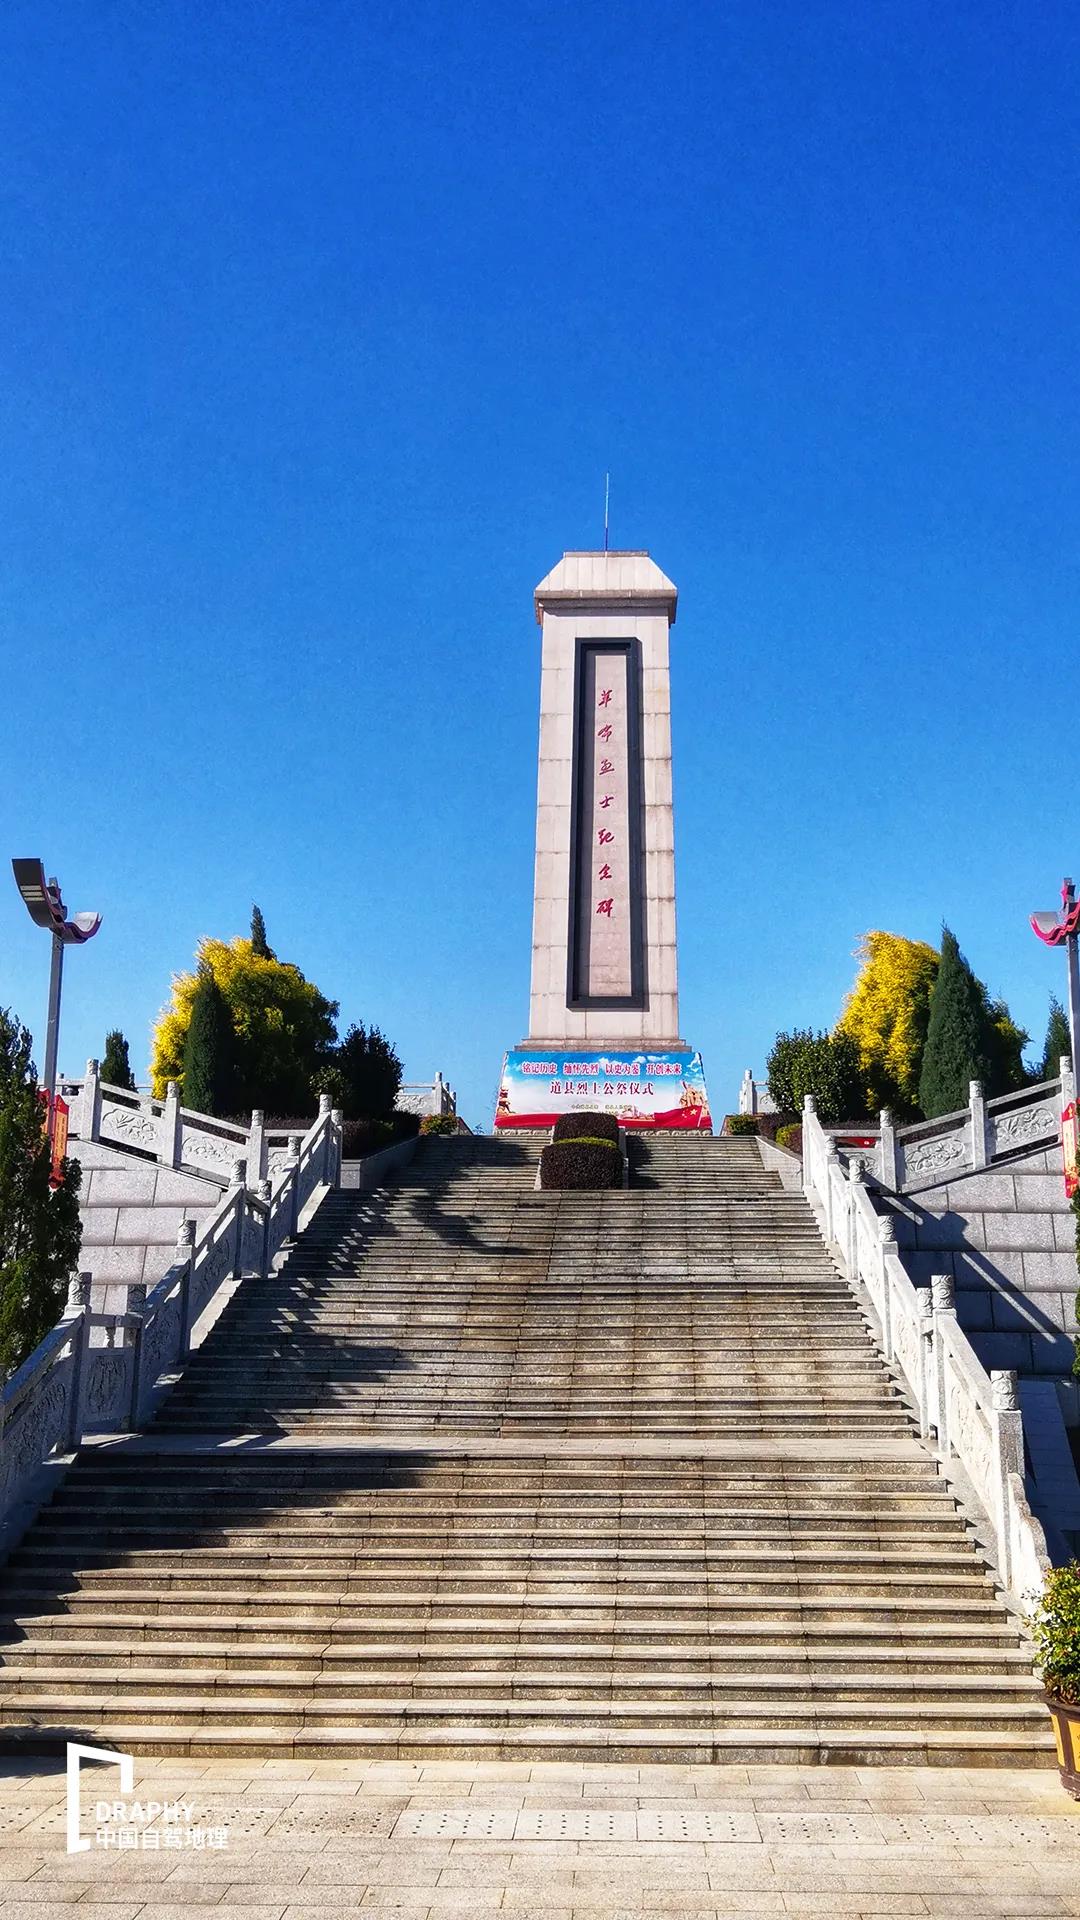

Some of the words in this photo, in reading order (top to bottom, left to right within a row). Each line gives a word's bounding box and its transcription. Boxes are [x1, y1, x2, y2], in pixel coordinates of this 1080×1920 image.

[596, 689, 615, 917] 革命烈士纪念碑
[522, 1062, 557, 1075] 铭记历史
[563, 1062, 599, 1075] 缅怀先烈
[605, 1062, 641, 1075] 以史为鉴
[646, 1062, 682, 1075] 开创未来
[550, 1081, 654, 1095] 道县烈士公祭仪式
